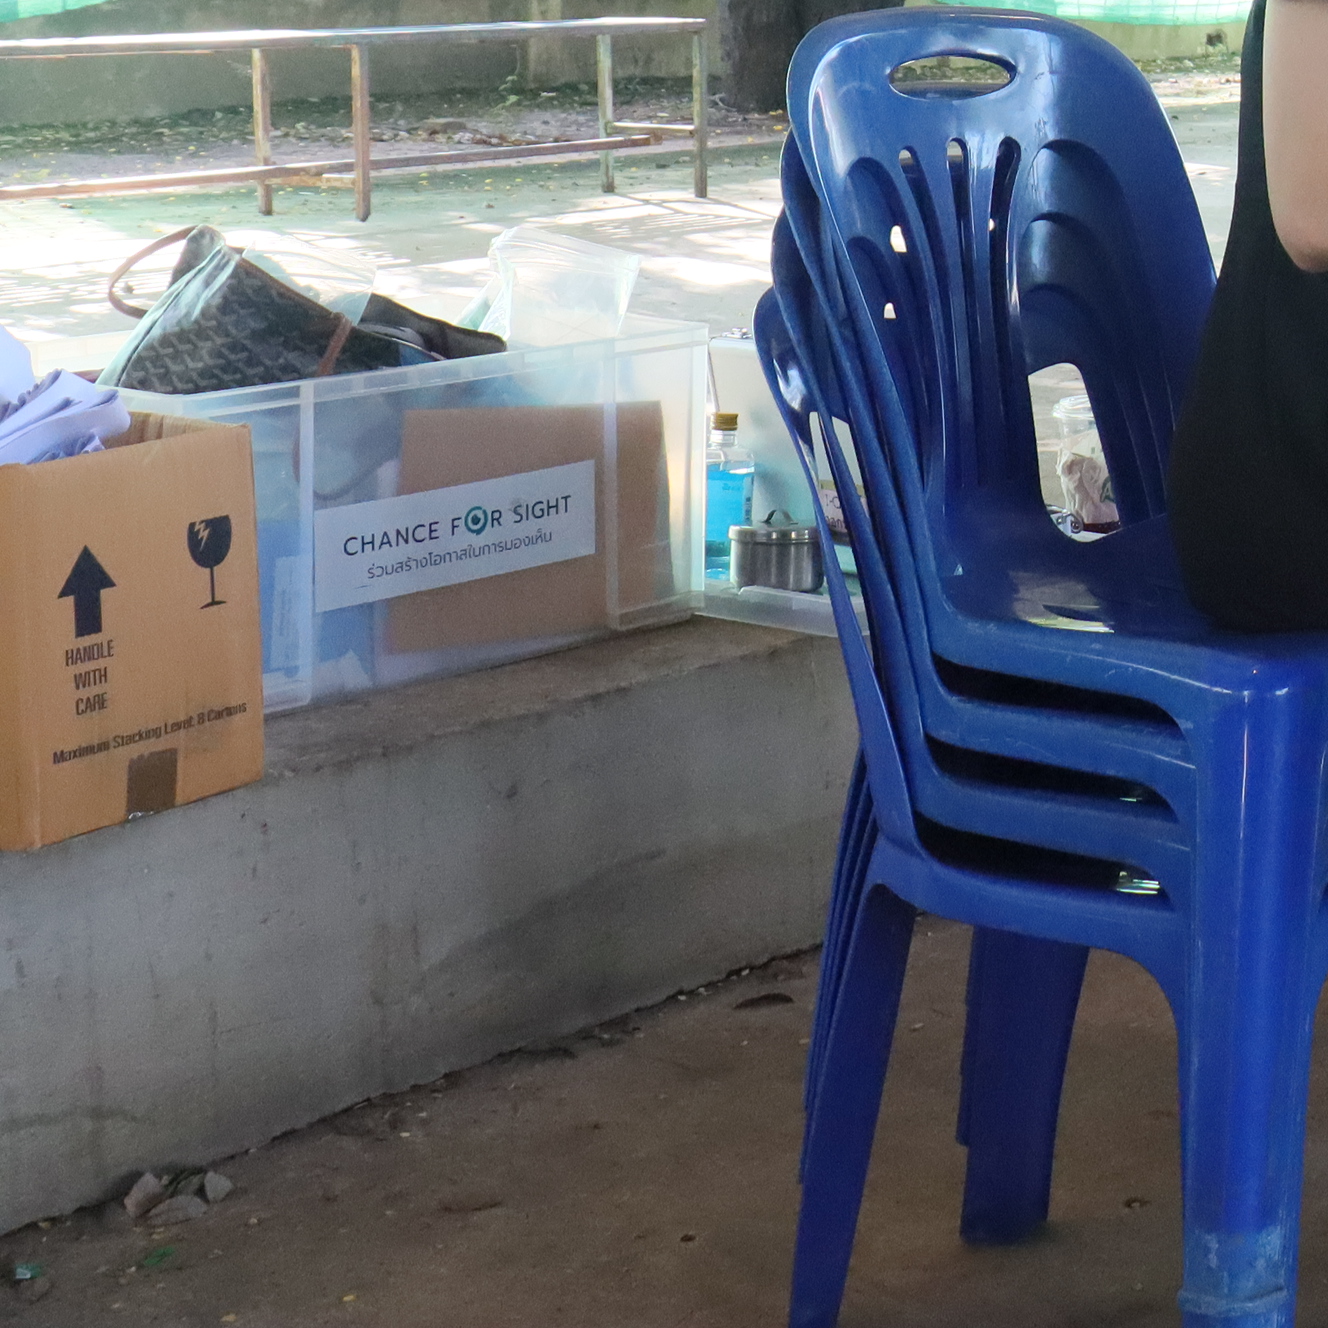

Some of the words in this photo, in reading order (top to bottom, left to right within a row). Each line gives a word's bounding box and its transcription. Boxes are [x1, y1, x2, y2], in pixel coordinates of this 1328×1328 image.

[343, 521, 440, 557] CHANCE
[451, 505, 502, 536] FOR
[513, 495, 571, 524] SIGHT
[65, 639, 114, 667] HANDLE
[74, 667, 108, 690] WITH
[75, 692, 108, 716] CARE
[53, 739, 112, 765] Maximum
[113, 724, 162, 749] Stacking
